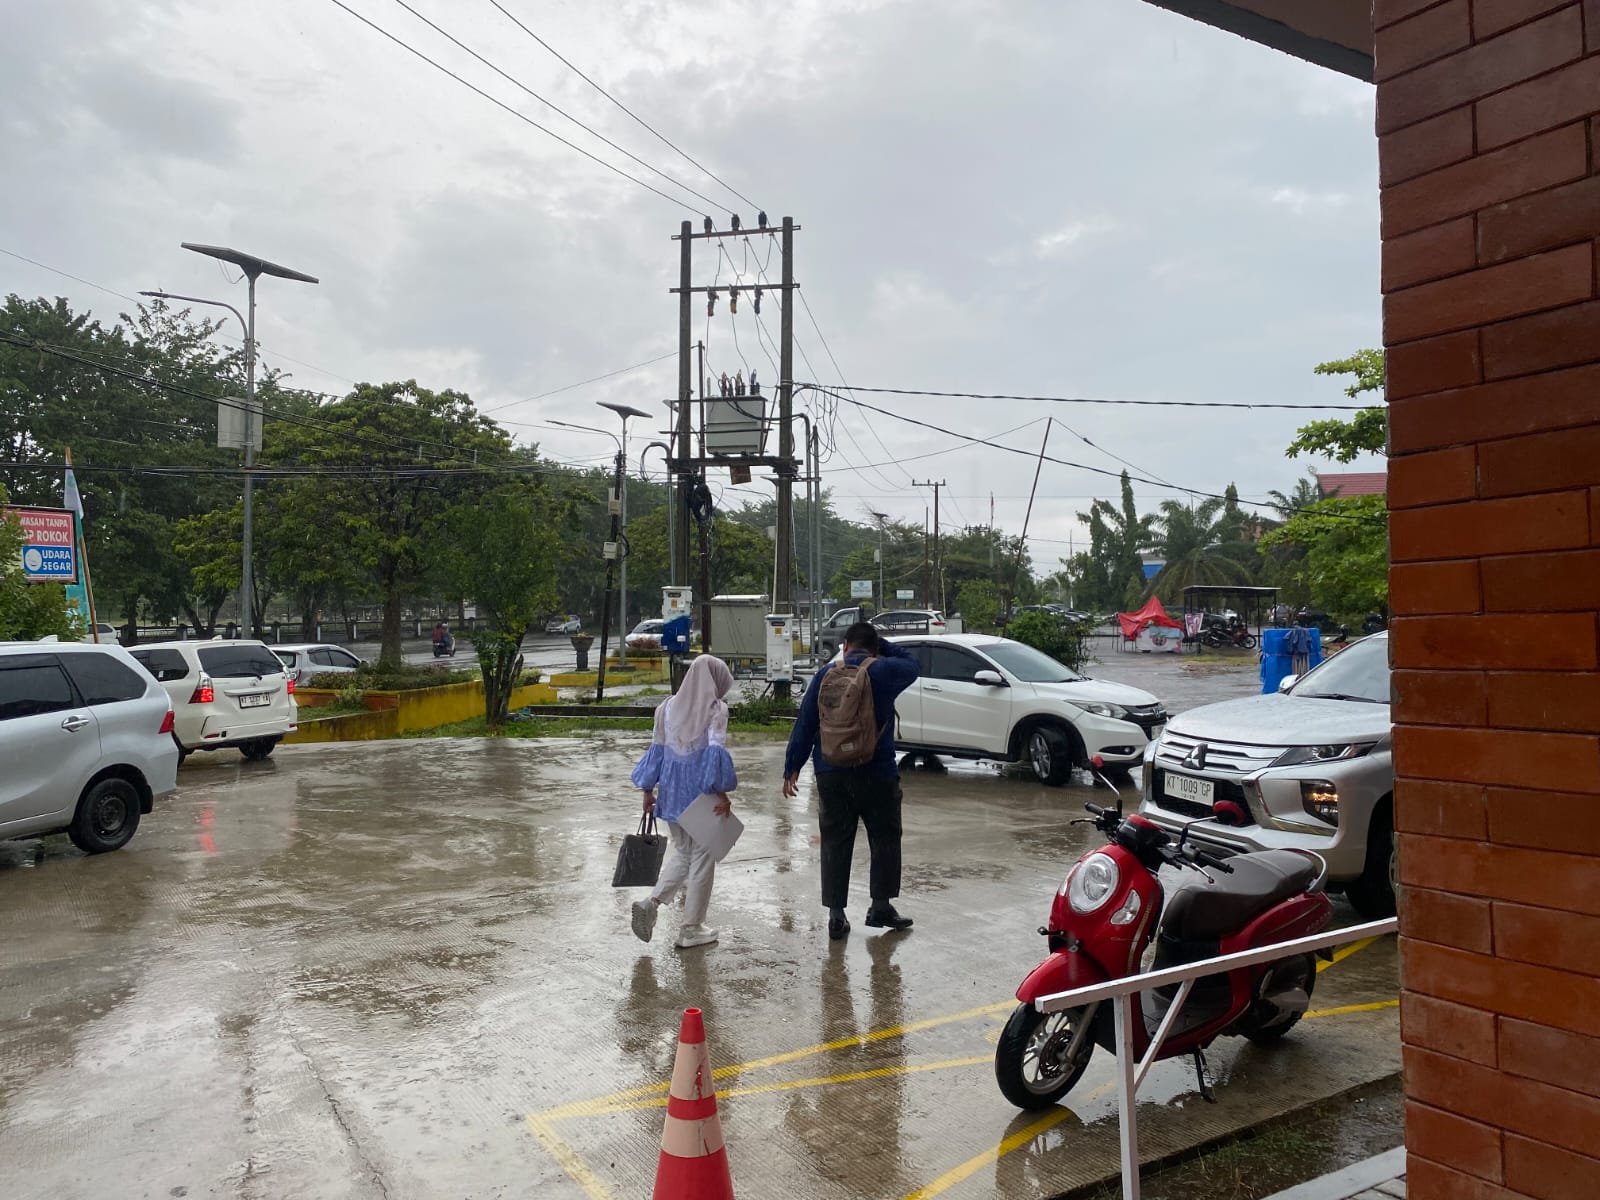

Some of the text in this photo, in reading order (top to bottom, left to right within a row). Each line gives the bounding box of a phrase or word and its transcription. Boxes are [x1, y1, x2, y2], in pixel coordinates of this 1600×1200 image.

[20, 516, 68, 528] WASAN TANPA
[37, 530, 69, 542] ROKOK
[42, 550, 71, 559] UDARA
[42, 562, 71, 571] SEGAR
[1166, 775, 1176, 789] KT
[1180, 777, 1197, 794] 1009
